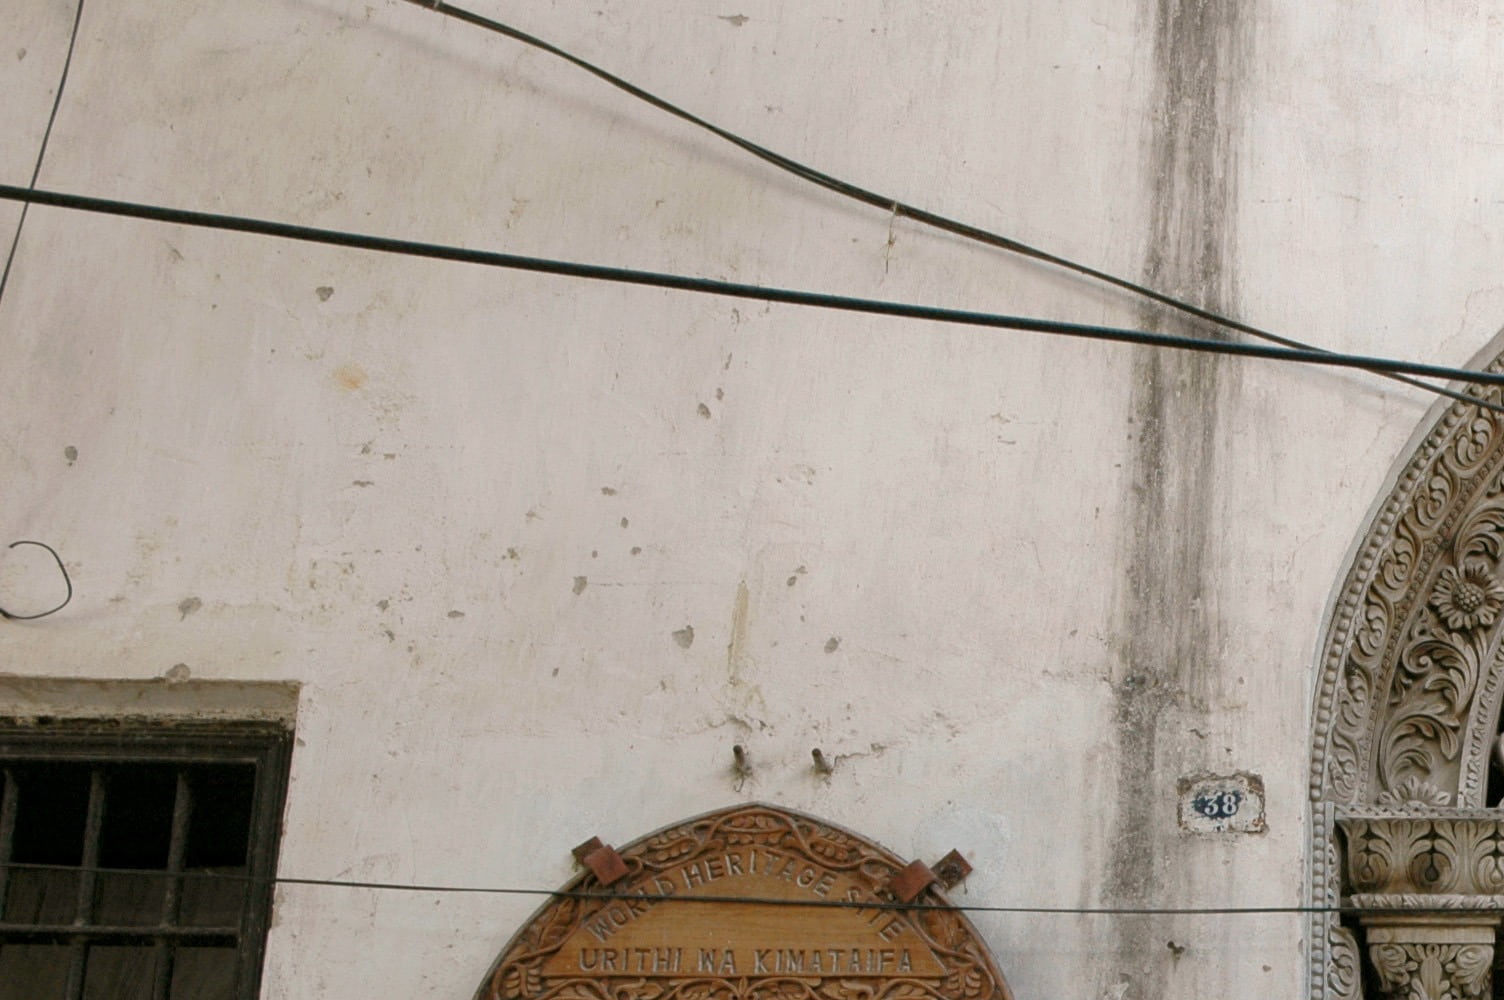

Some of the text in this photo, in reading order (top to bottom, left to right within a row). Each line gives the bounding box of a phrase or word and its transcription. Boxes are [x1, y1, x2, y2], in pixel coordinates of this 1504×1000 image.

[1204, 792, 1237, 816] 38
[585, 850, 906, 942] WORLD HERITAGE SITE
[578, 948, 913, 974] URITHI WA KIMATAIFA
